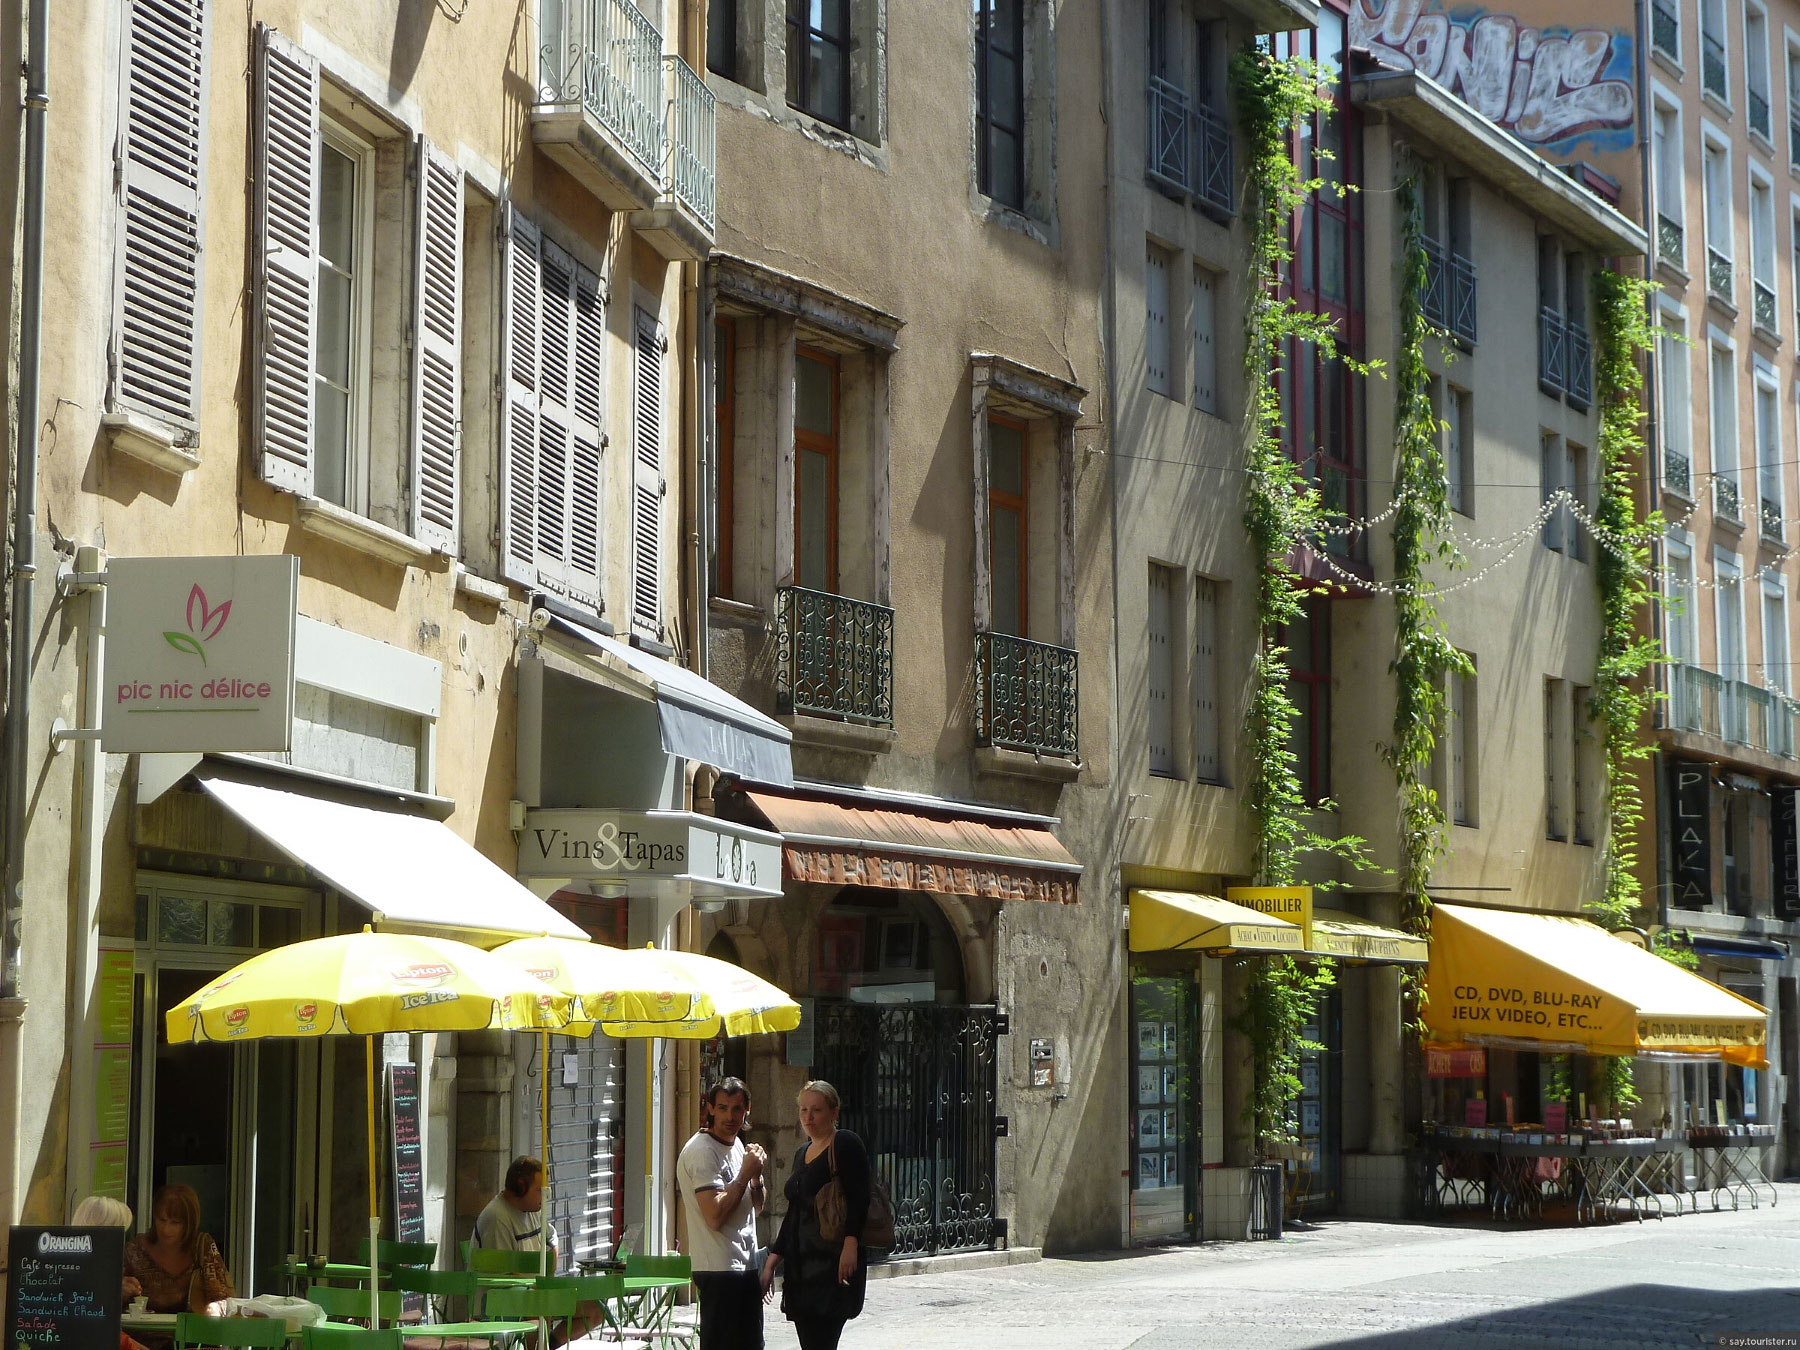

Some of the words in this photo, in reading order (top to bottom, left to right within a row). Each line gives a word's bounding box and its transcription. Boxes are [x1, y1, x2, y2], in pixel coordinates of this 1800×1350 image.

[118, 680, 152, 704] pic
[160, 680, 193, 699] nic
[201, 677, 271, 698] délice
[1232, 898, 1303, 913] MMOBILIER
[1454, 986, 1482, 1002] CD,
[1488, 987, 1527, 1005] DVD,
[1533, 990, 1602, 1009] BLU-RAY
[1452, 1006, 1490, 1020] JEUX
[1496, 1008, 1551, 1027] VIDEO,
[38, 1231, 93, 1253] ORANGINA
[18, 1288, 63, 1302] Sandwich
[18, 1302, 69, 1316] Sandwich
[17, 1317, 56, 1330] Salade
[16, 1329, 61, 1342] Quiche
